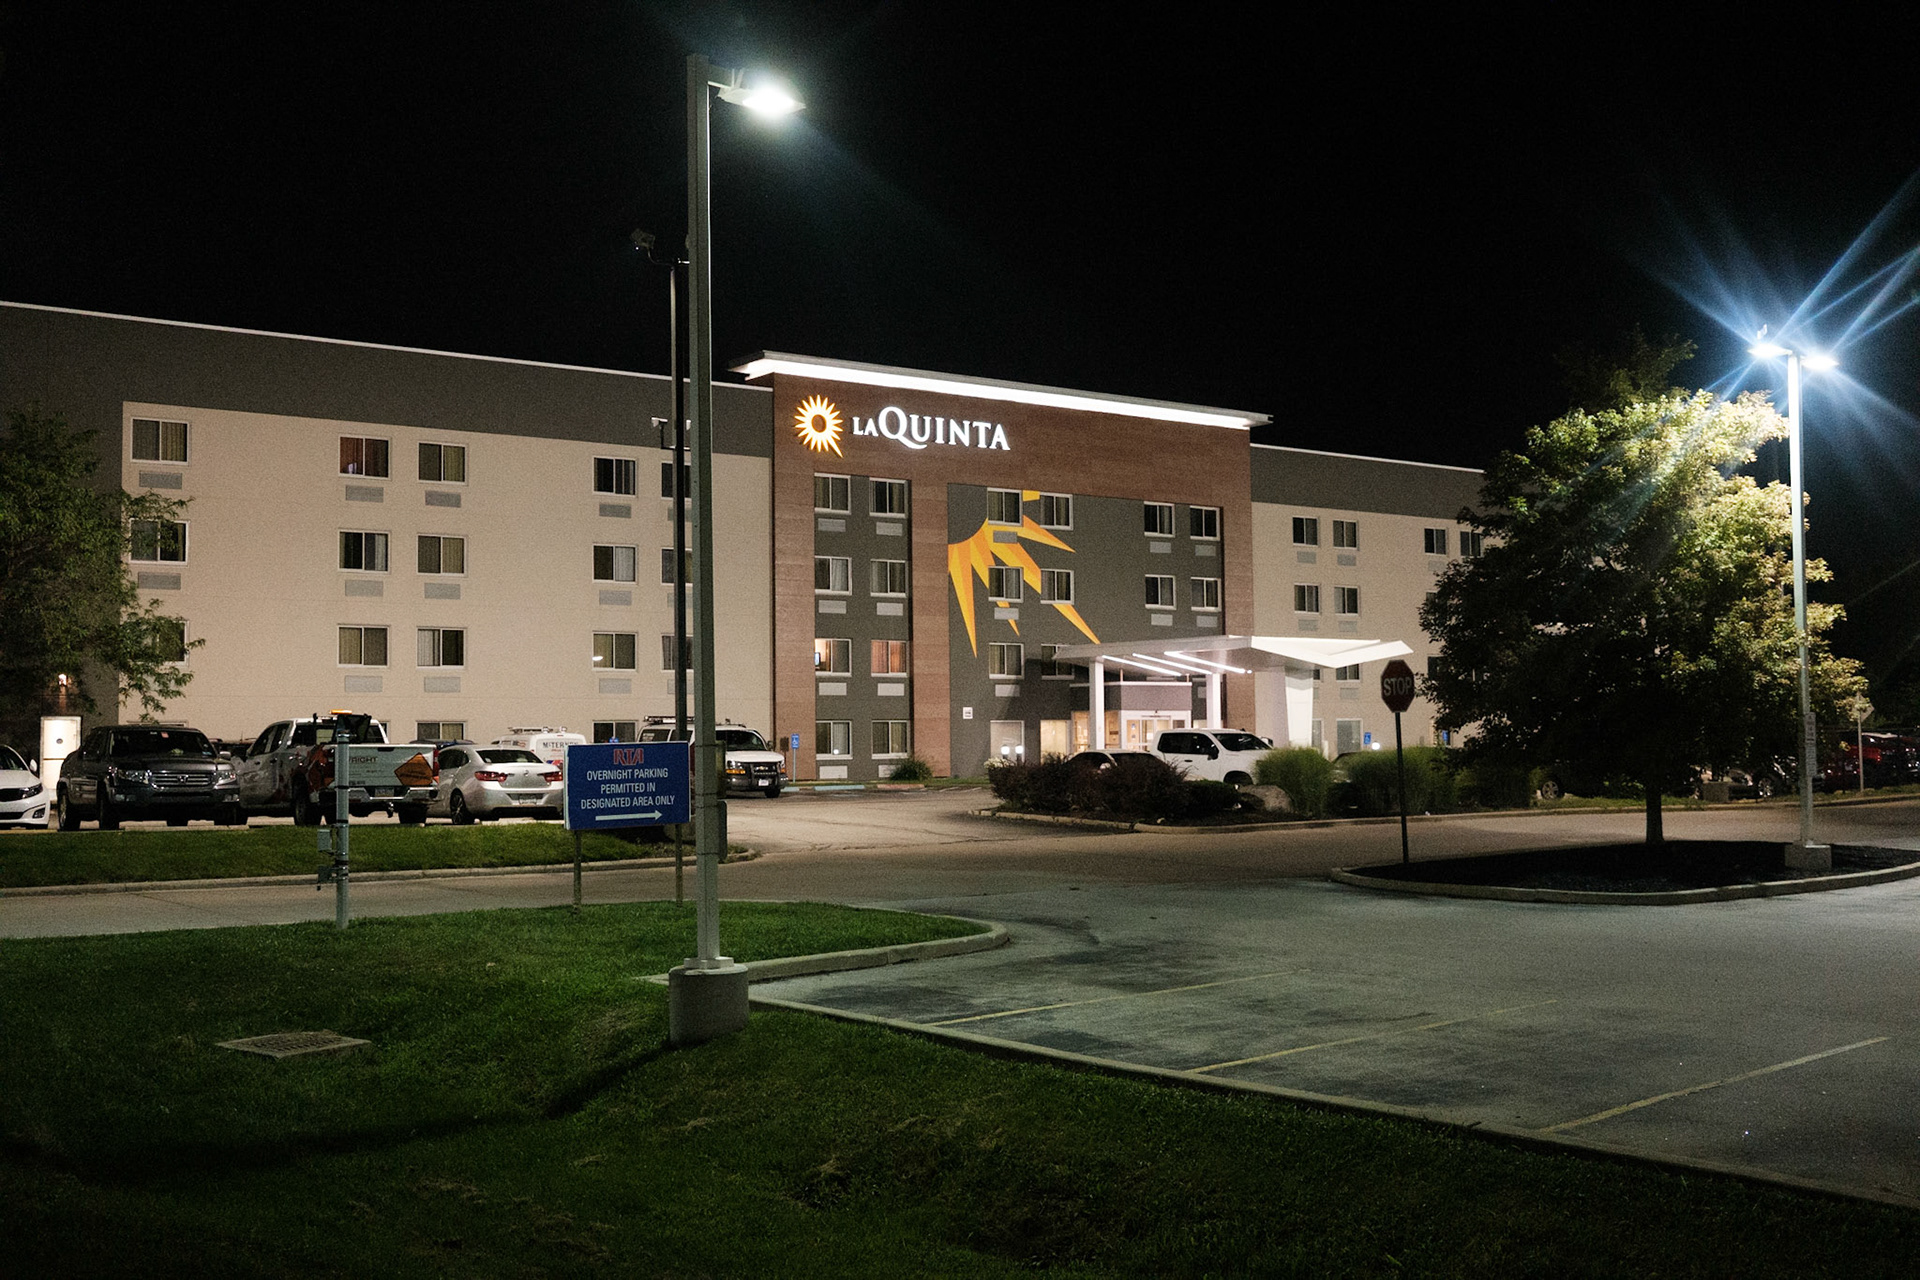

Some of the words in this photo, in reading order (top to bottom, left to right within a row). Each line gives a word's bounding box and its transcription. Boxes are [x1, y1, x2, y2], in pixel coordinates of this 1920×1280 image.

[852, 416, 878, 437] LA
[878, 406, 1011, 450] QUINTA
[1383, 676, 1412, 696] STOP
[349, 756, 378, 764] RIGHT
[613, 748, 645, 766] RTA
[586, 769, 632, 781] OVERNIGHT
[634, 768, 669, 778] PARKING
[600, 783, 645, 794] PERMITTED
[647, 782, 656, 792] IN
[581, 797, 631, 809] DESIGNATED
[632, 796, 654, 806] AREA
[655, 795, 675, 805] ONLY
